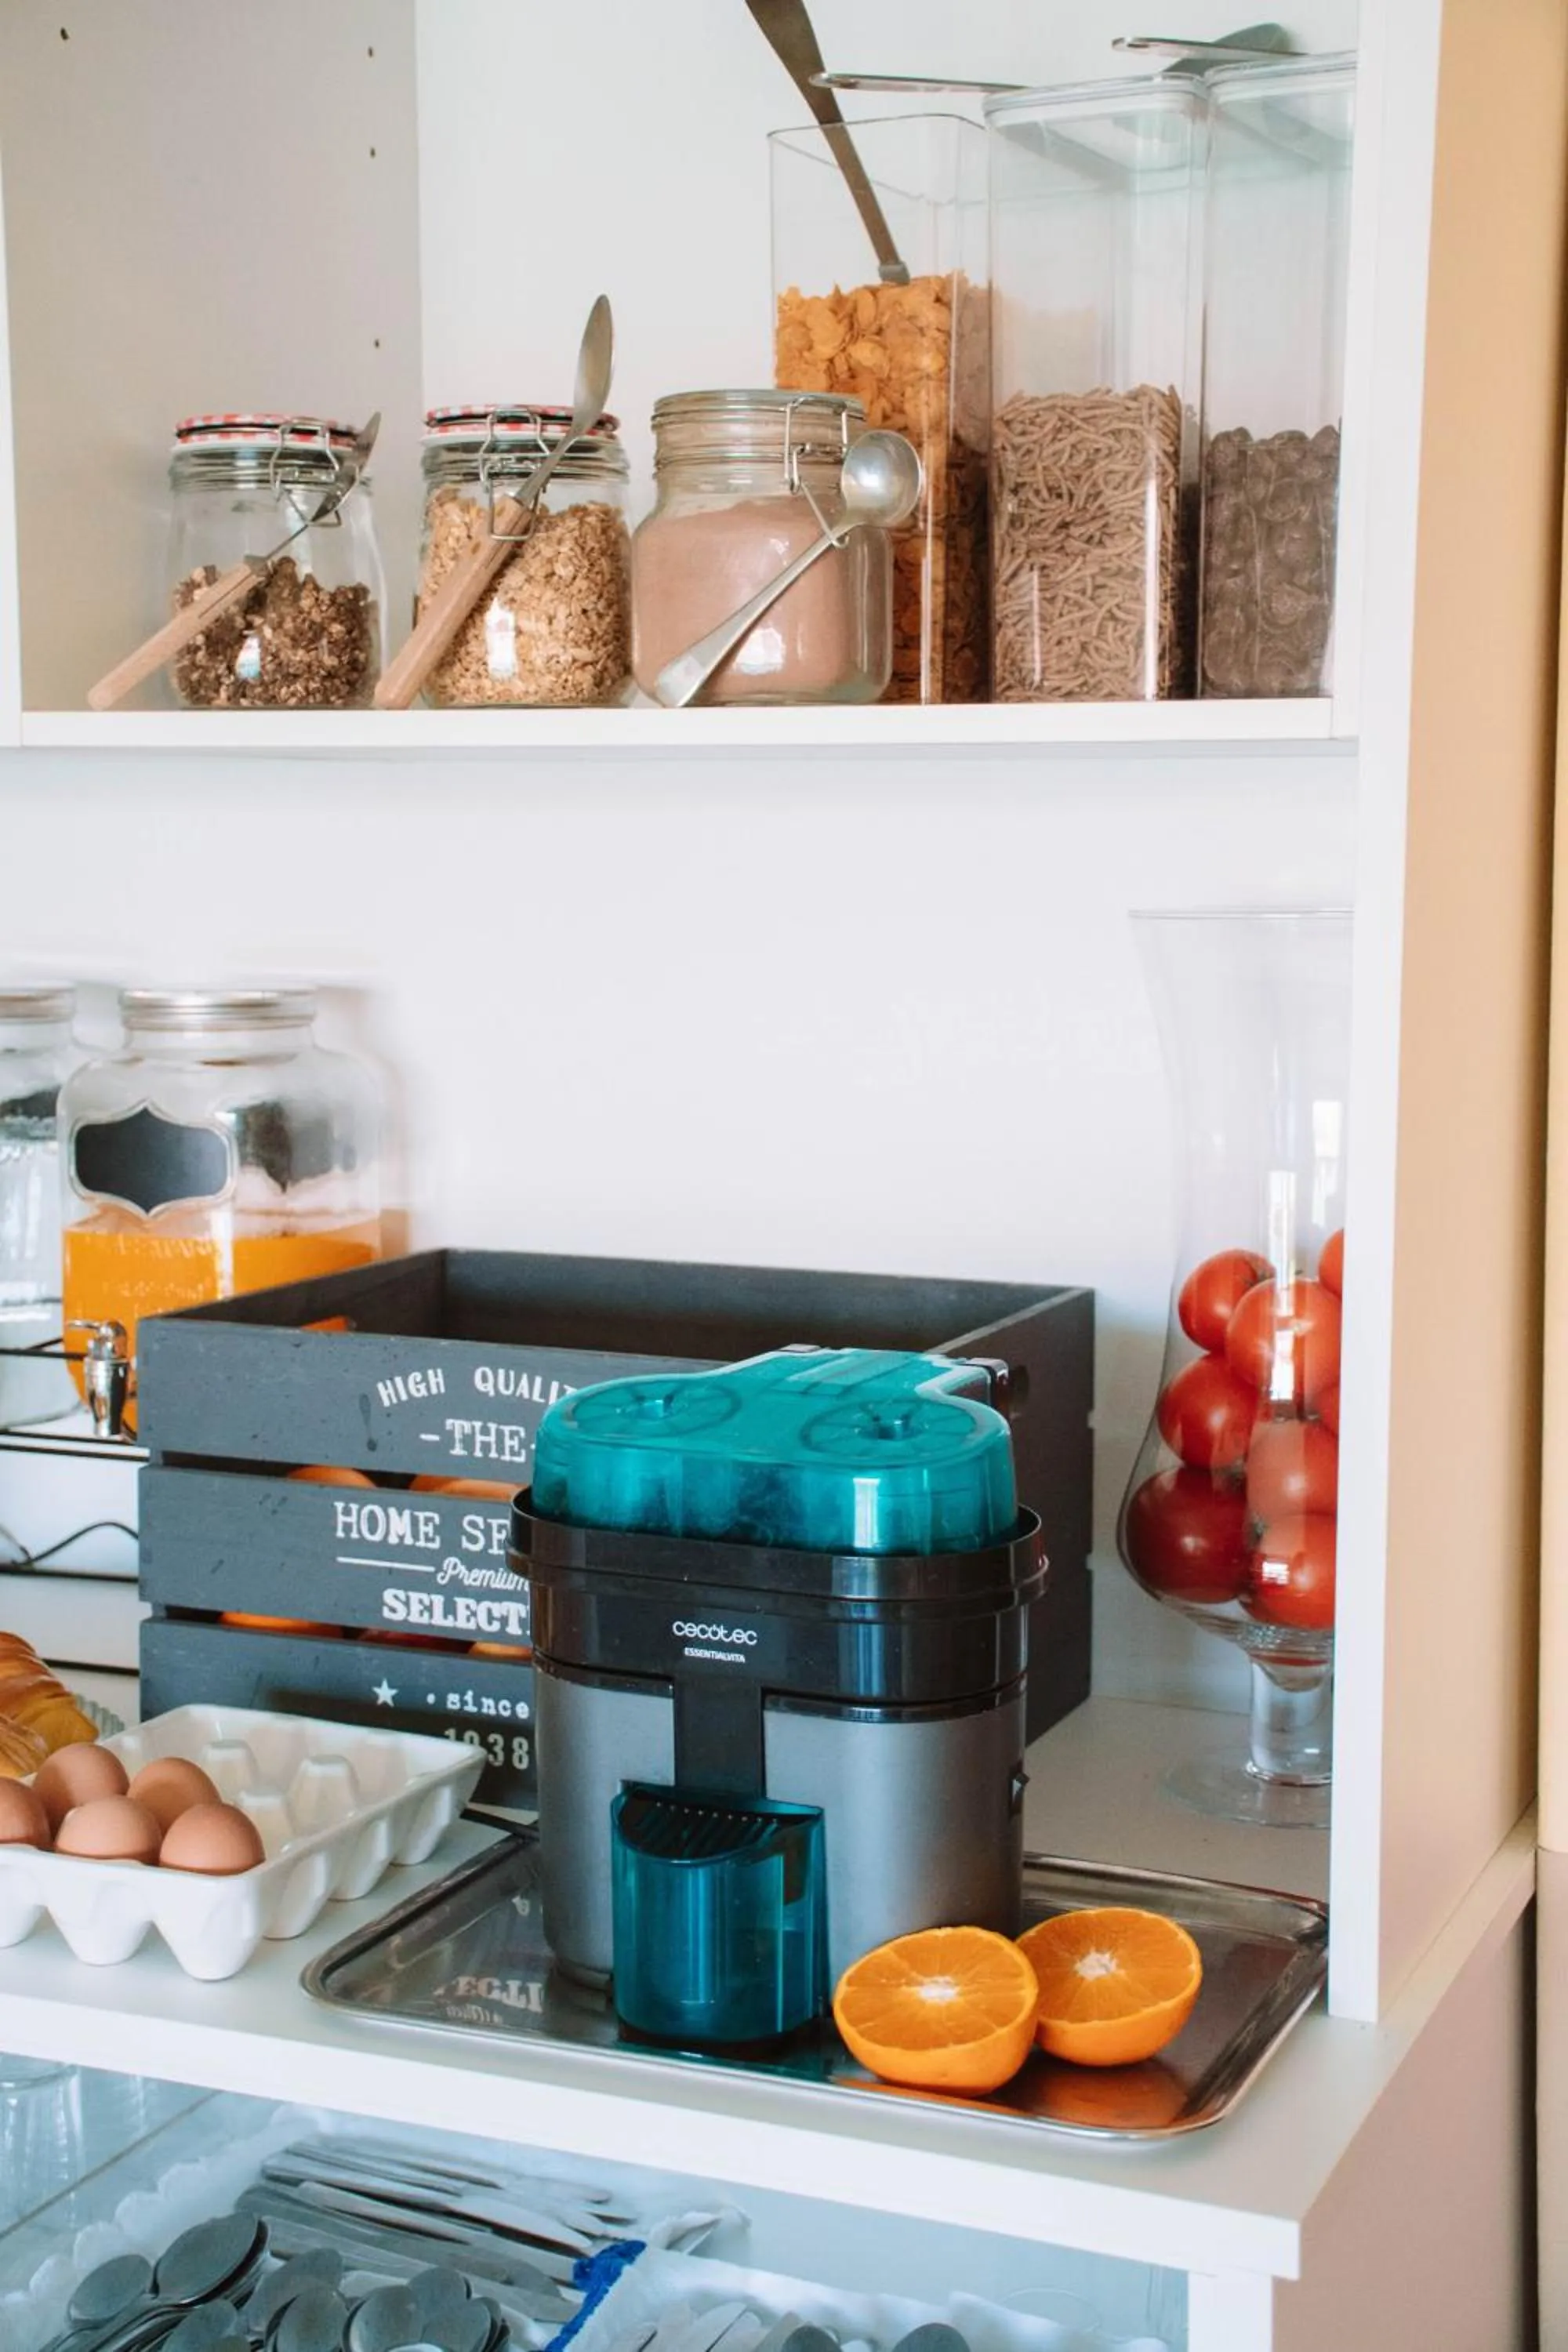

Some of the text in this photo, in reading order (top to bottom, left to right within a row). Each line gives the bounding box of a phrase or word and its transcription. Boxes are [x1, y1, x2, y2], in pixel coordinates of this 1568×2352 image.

[376, 1368, 445, 1407] HIGH
[334, 1501, 440, 1550] HOME
[382, 1588, 531, 1635] SELECT
[672, 1620, 758, 1646] cecotec
[446, 1689, 530, 1719] since
